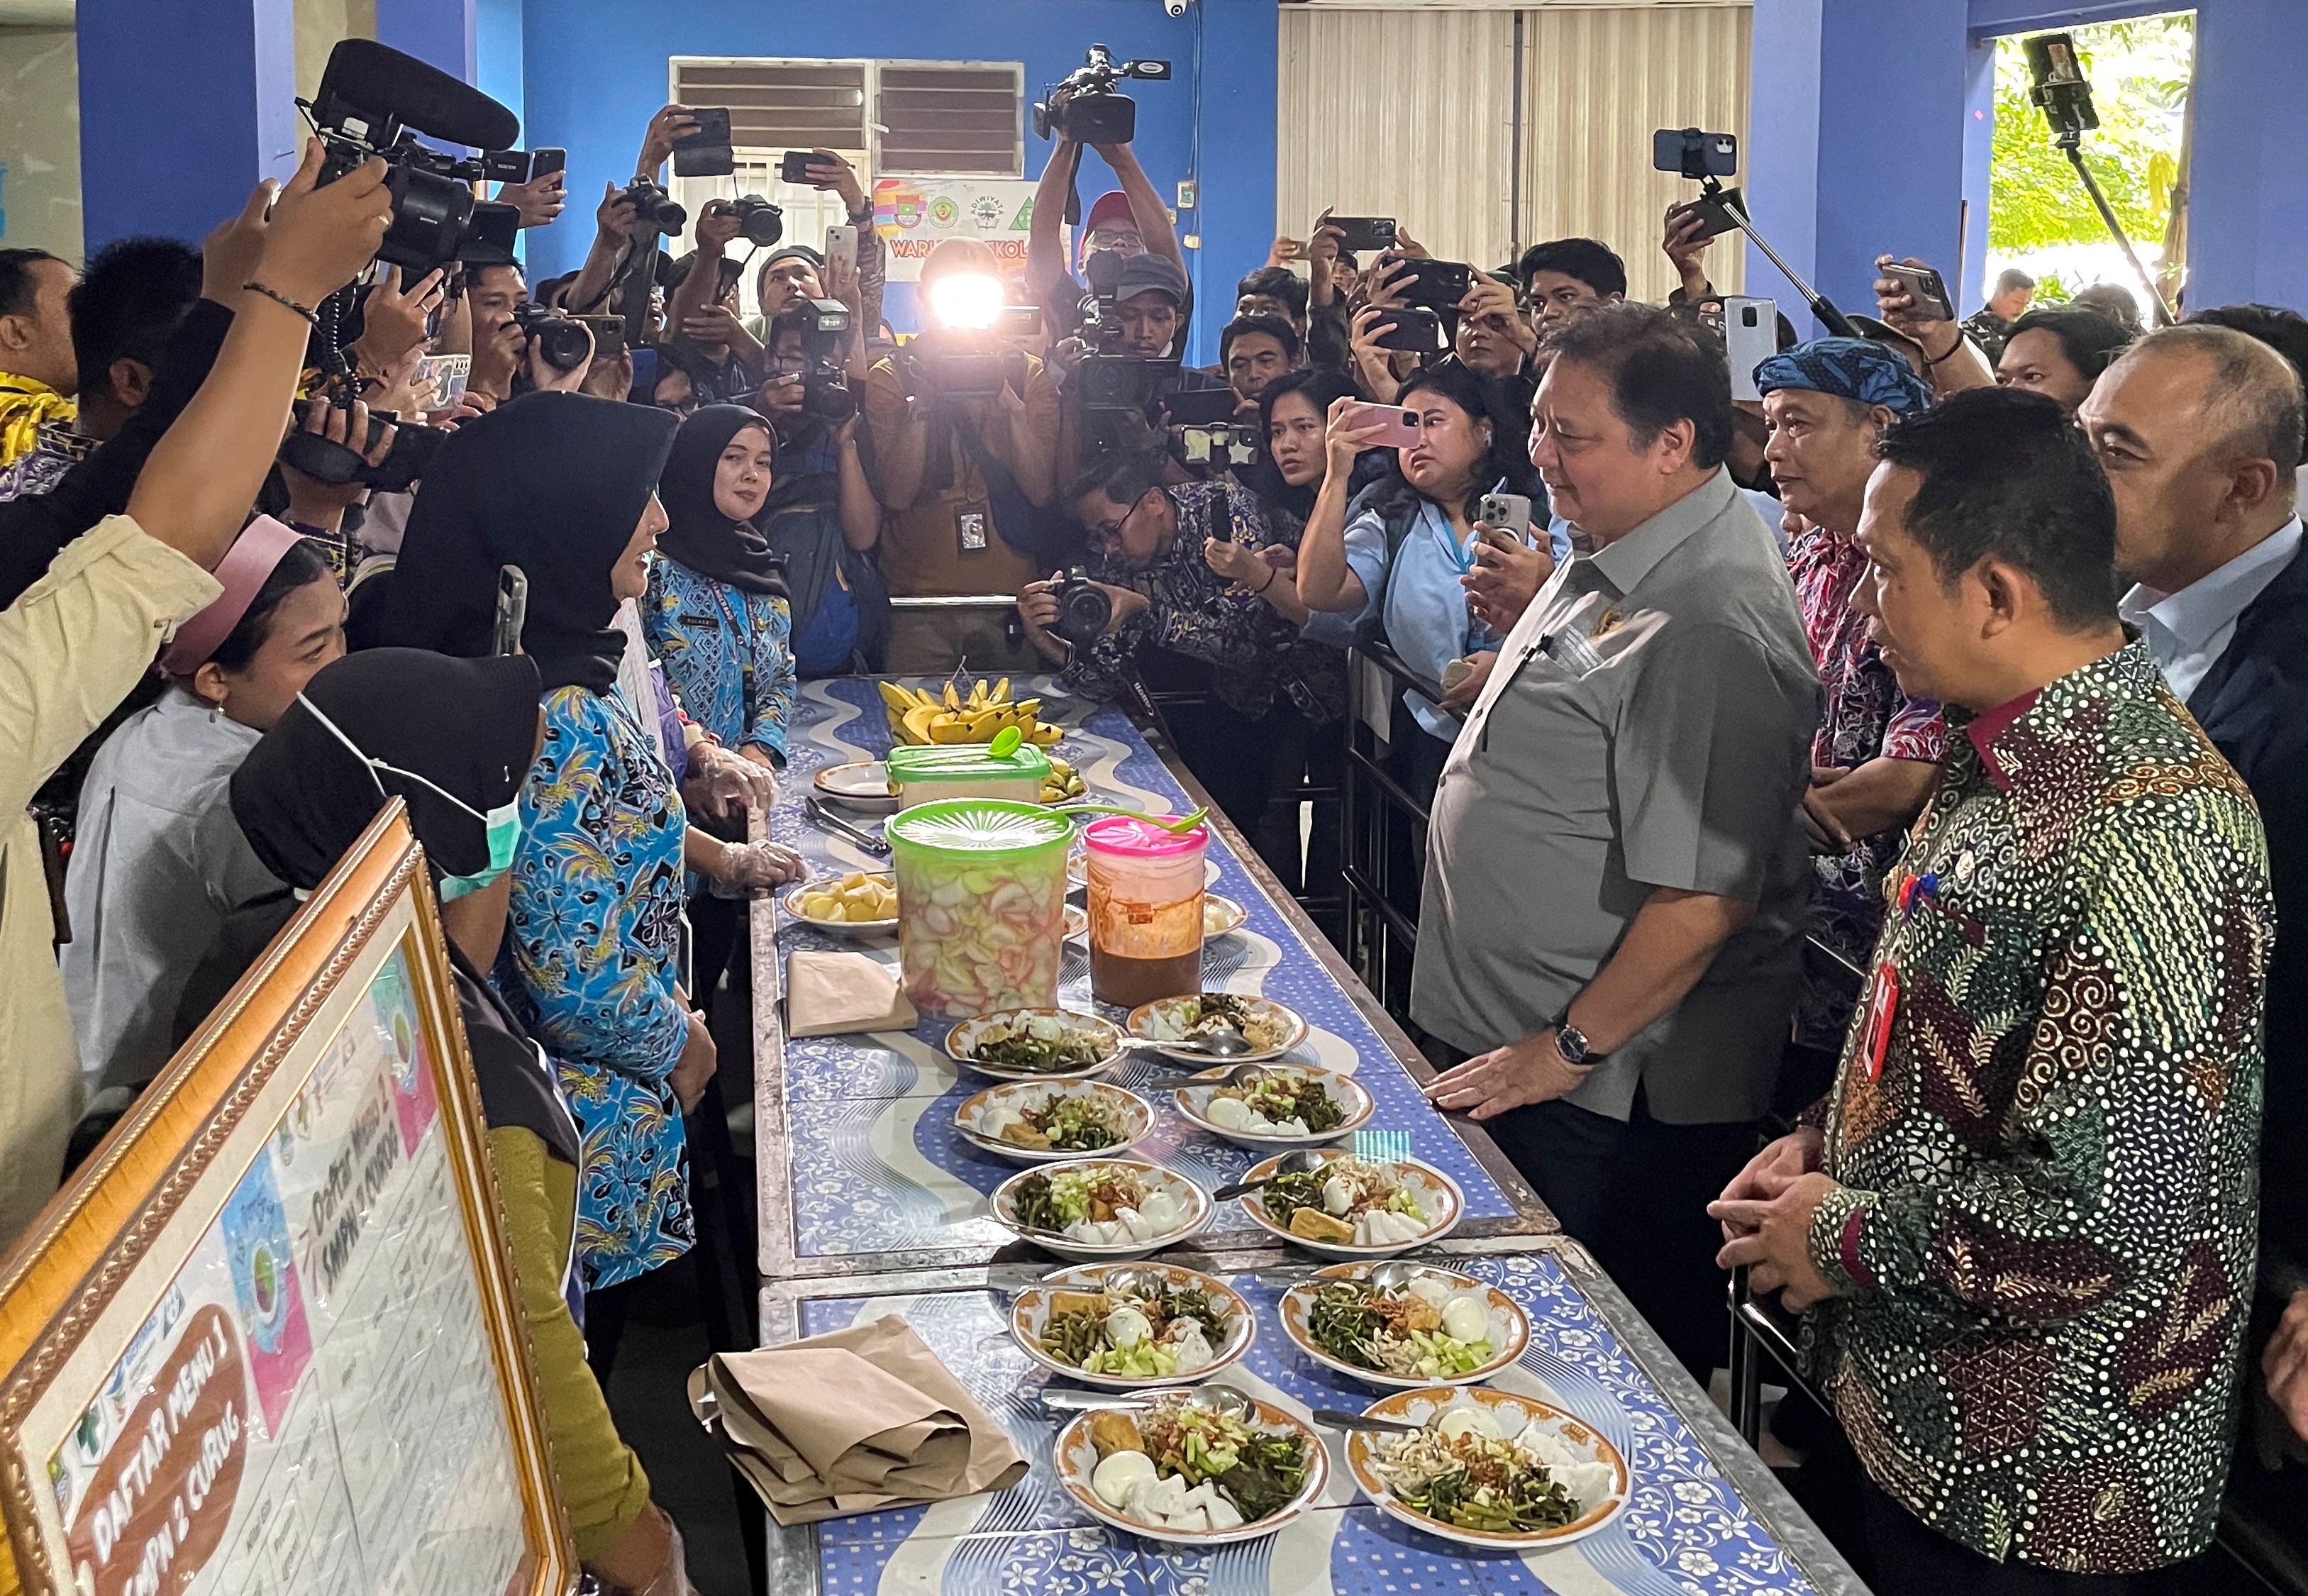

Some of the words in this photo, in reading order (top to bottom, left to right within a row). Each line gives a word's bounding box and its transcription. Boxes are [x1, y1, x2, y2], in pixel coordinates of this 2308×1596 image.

[970, 195, 1004, 215] ADIWIYATA
[1133, 682, 1154, 716] Canon
[94, 1407, 171, 1564] DAFTAR
[167, 1336, 214, 1434] MENU
[213, 1314, 228, 1359] 1
[172, 1495, 190, 1544] 2
[187, 1400, 240, 1512] CURUG
